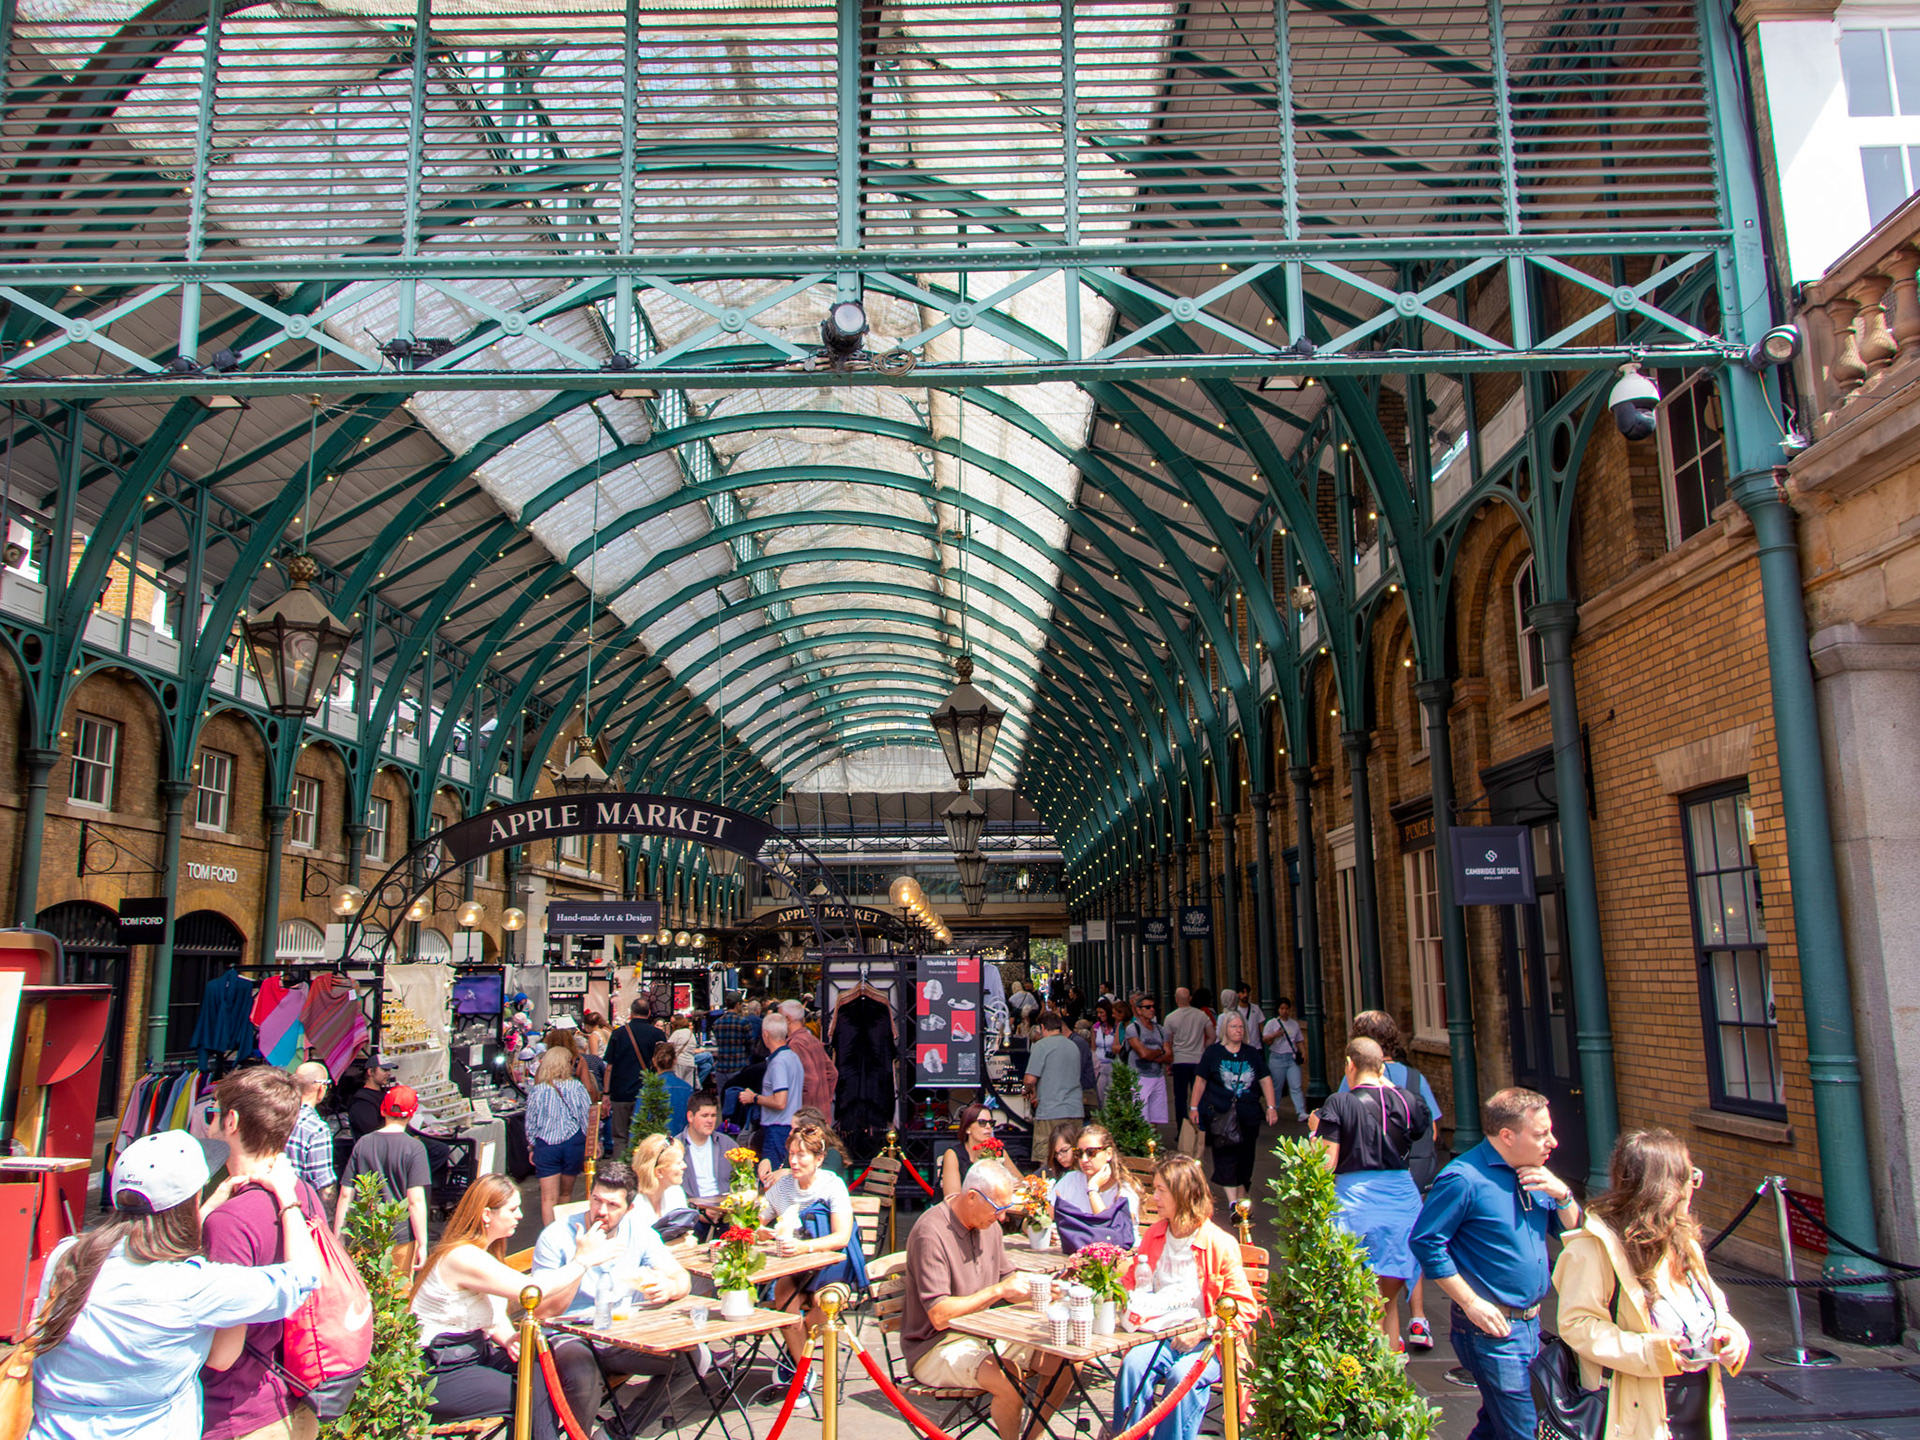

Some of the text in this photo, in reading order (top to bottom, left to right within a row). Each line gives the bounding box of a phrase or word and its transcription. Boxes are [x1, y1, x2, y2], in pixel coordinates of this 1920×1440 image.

[488, 802, 732, 843] APPLE MARKET
[187, 862, 238, 883] TOM FORD
[1465, 867, 1520, 876] CAMBRIDGE SATCHEL
[119, 916, 164, 926] TOM FORD
[556, 913, 652, 923] Hand-made Art & Design
[777, 907, 881, 924] APPLE MAKET
